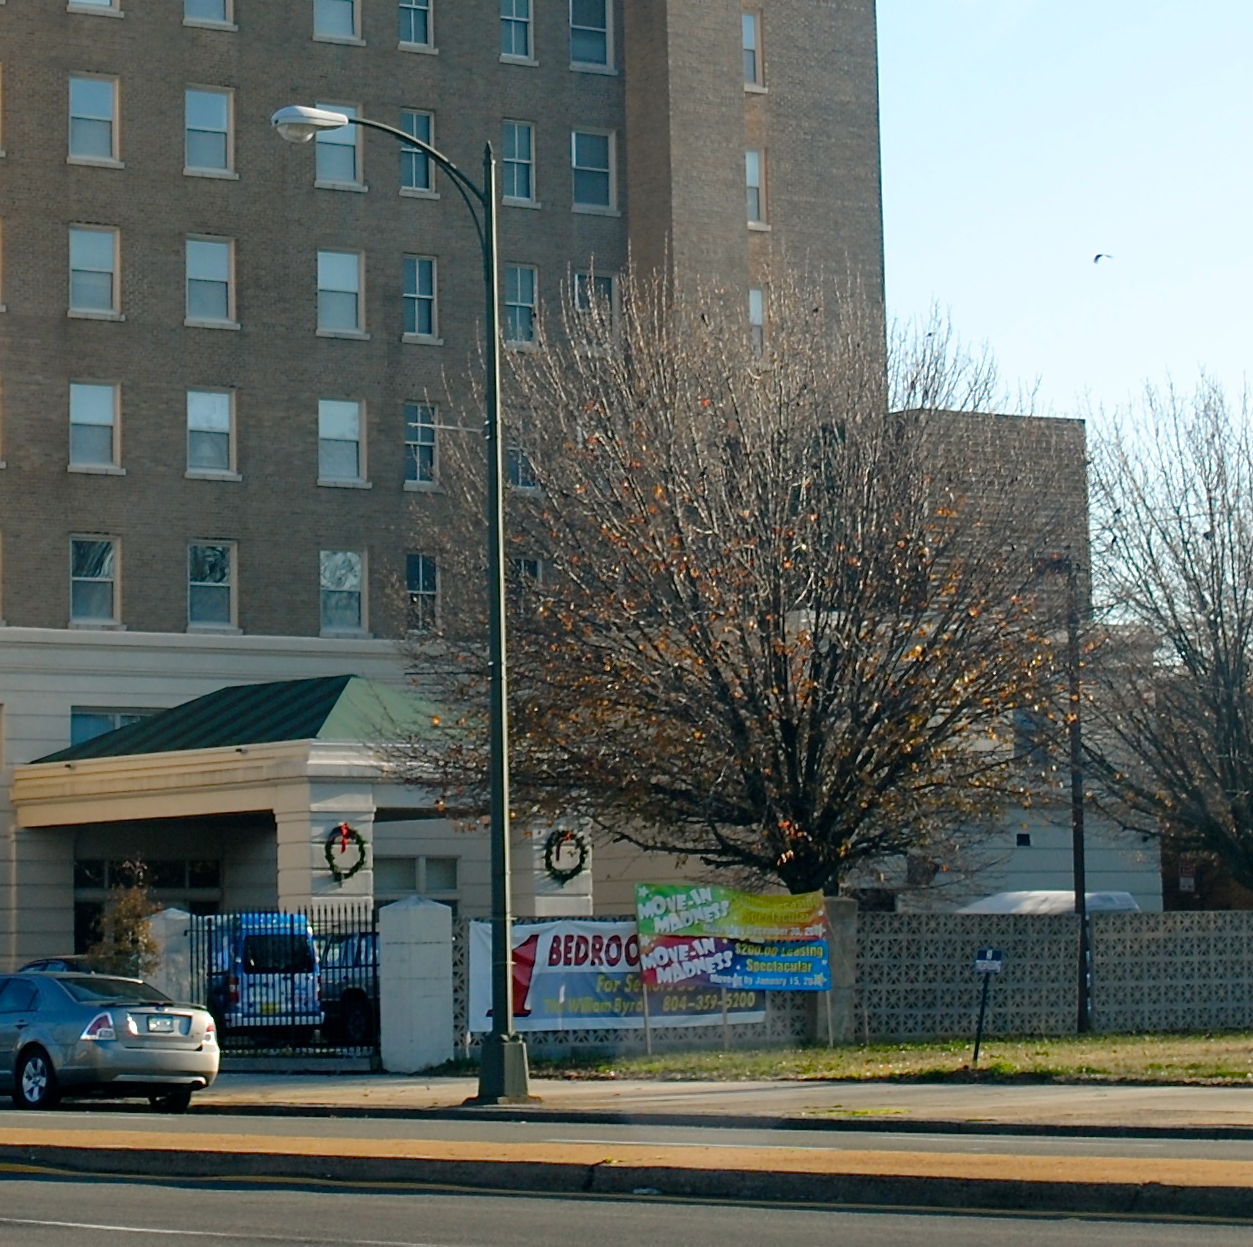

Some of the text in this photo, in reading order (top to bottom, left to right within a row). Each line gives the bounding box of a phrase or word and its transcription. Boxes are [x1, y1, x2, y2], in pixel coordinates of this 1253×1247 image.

[638, 888, 713, 920] MOVE-IN
[654, 900, 730, 933] MADNESS
[547, 934, 641, 967] BEDROO
[640, 937, 716, 970] MOVE-IN
[746, 959, 813, 973] Spectacular
[781, 945, 824, 960] Leasing
[486, 934, 540, 1017] 1
[596, 974, 621, 993] For
[656, 951, 734, 984] MADNESS
[755, 976, 787, 987] January
[568, 996, 612, 1013] William
[613, 996, 644, 1018] Byrd
